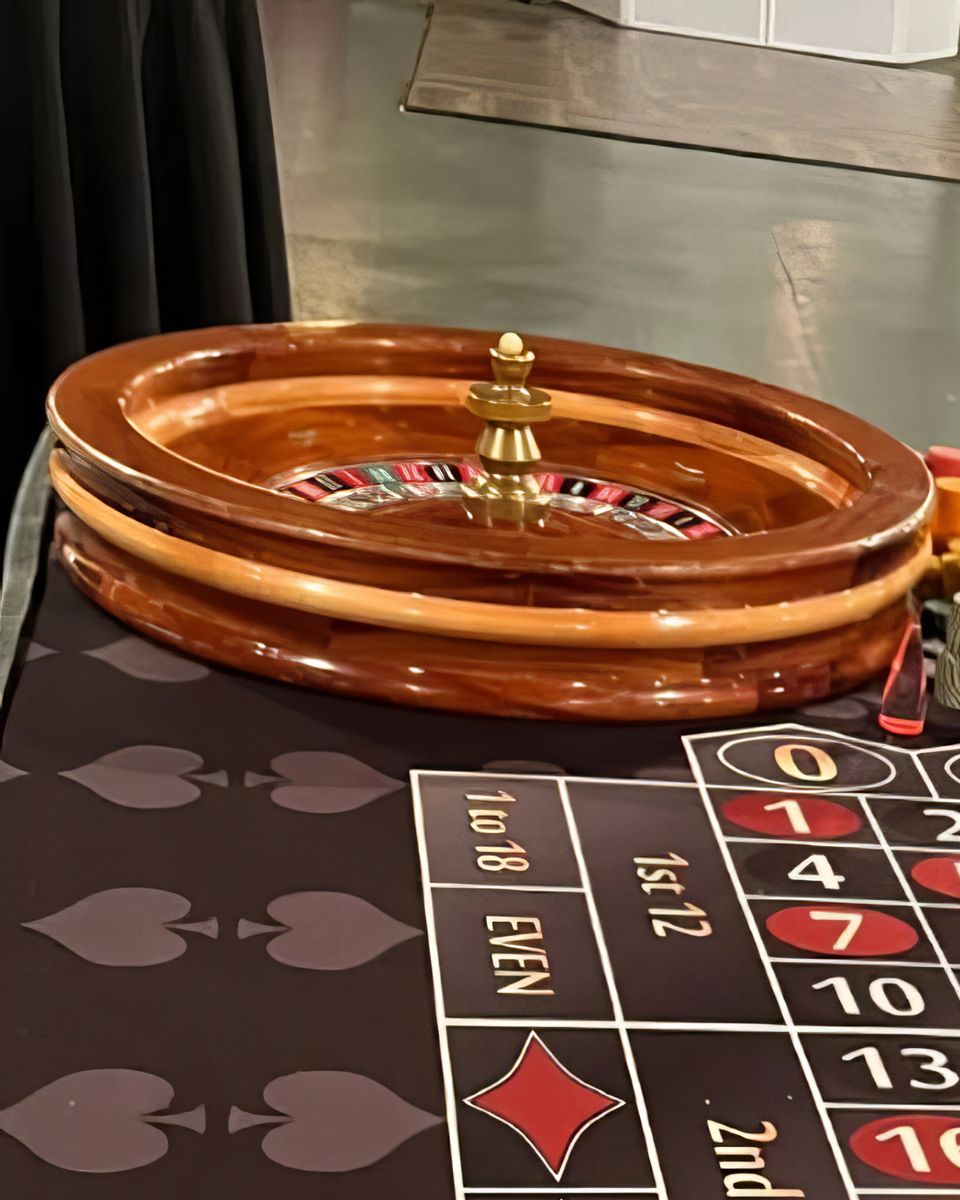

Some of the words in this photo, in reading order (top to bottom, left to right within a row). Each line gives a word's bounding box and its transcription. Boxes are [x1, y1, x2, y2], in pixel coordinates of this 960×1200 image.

[775, 744, 837, 781] 0
[465, 790, 516, 801] 1
[468, 809, 508, 833] to
[764, 800, 810, 834] 1
[474, 839, 529, 871] 18
[633, 852, 689, 894] 1st
[788, 854, 845, 890] 4
[648, 902, 712, 937] 12
[810, 911, 863, 950] 7
[486, 916, 554, 994] EVEN
[812, 977, 925, 1016] 10
[842, 1047, 959, 1089] 13
[707, 1119, 805, 1198] 2nd
